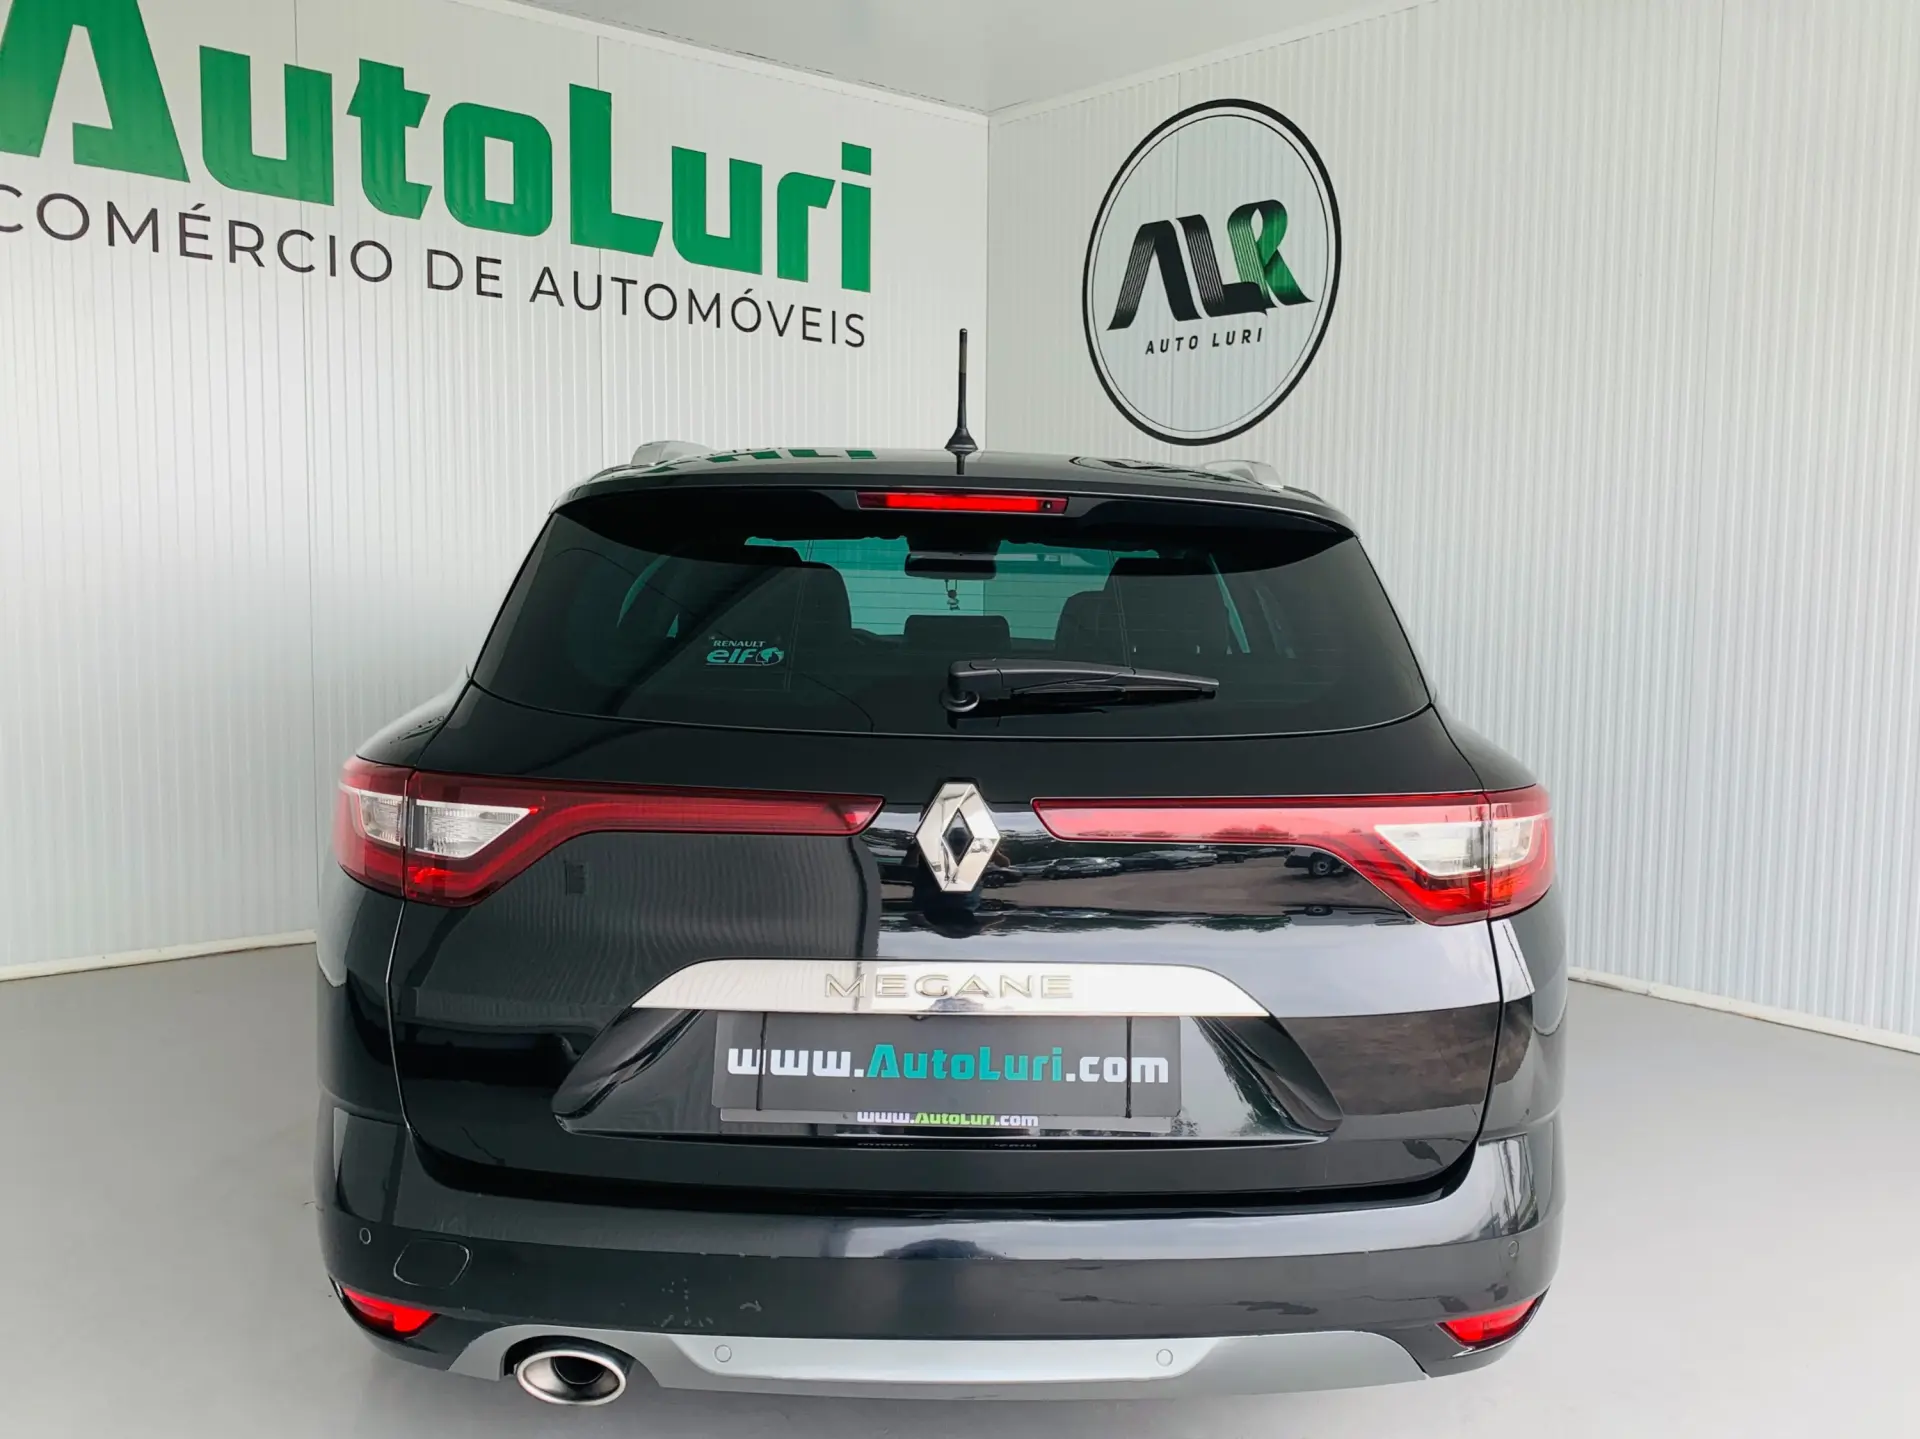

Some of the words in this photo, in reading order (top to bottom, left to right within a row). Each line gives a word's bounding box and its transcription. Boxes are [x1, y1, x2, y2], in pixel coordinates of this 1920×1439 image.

[0, 0, 872, 293] AutoLuri
[427, 249, 504, 299] DE
[529, 265, 867, 349] AUTOMÓVEIS
[1145, 335, 1199, 355] AUTO
[1212, 327, 1263, 348] LURI
[713, 640, 766, 648] RENAULT
[824, 973, 1075, 999] MEGANE
[727, 1043, 1170, 1084] www.AutoLuri.com
